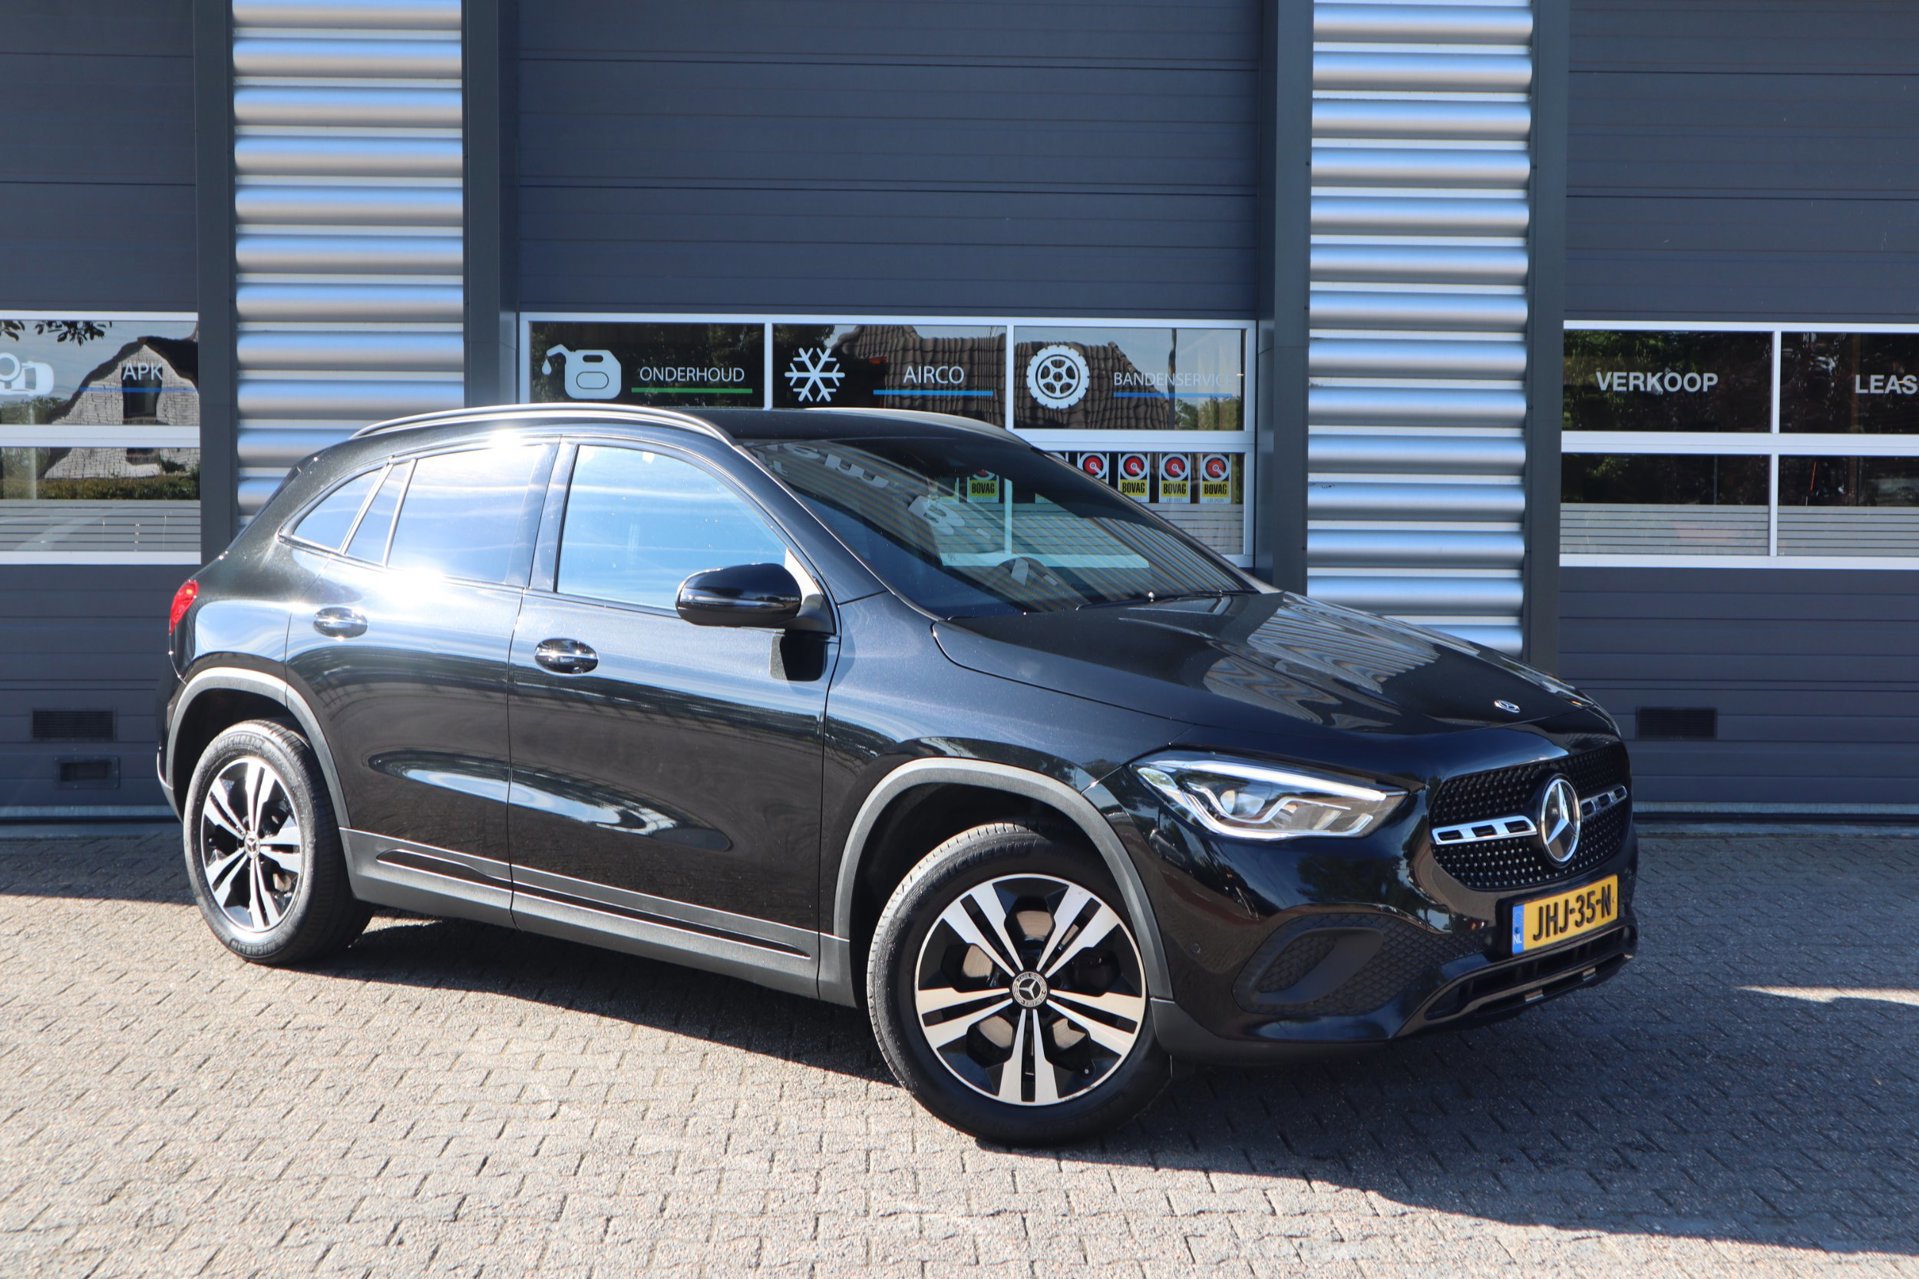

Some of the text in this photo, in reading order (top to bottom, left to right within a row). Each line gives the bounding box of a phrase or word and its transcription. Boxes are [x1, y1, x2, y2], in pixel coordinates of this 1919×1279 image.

[122, 362, 163, 381] APK
[639, 366, 745, 383] ONDERHOUD
[903, 365, 965, 385] AIRCO
[1596, 371, 1719, 393] VERKOOP
[1855, 374, 1919, 395] LEAS
[971, 482, 995, 494] BOVAG
[1122, 481, 1146, 494] BOVAG
[1163, 482, 1187, 495] BOVAG
[1204, 483, 1228, 496] BOVAG
[1533, 884, 1611, 941] JHJ-35-N
[1513, 934, 1522, 944] NL
